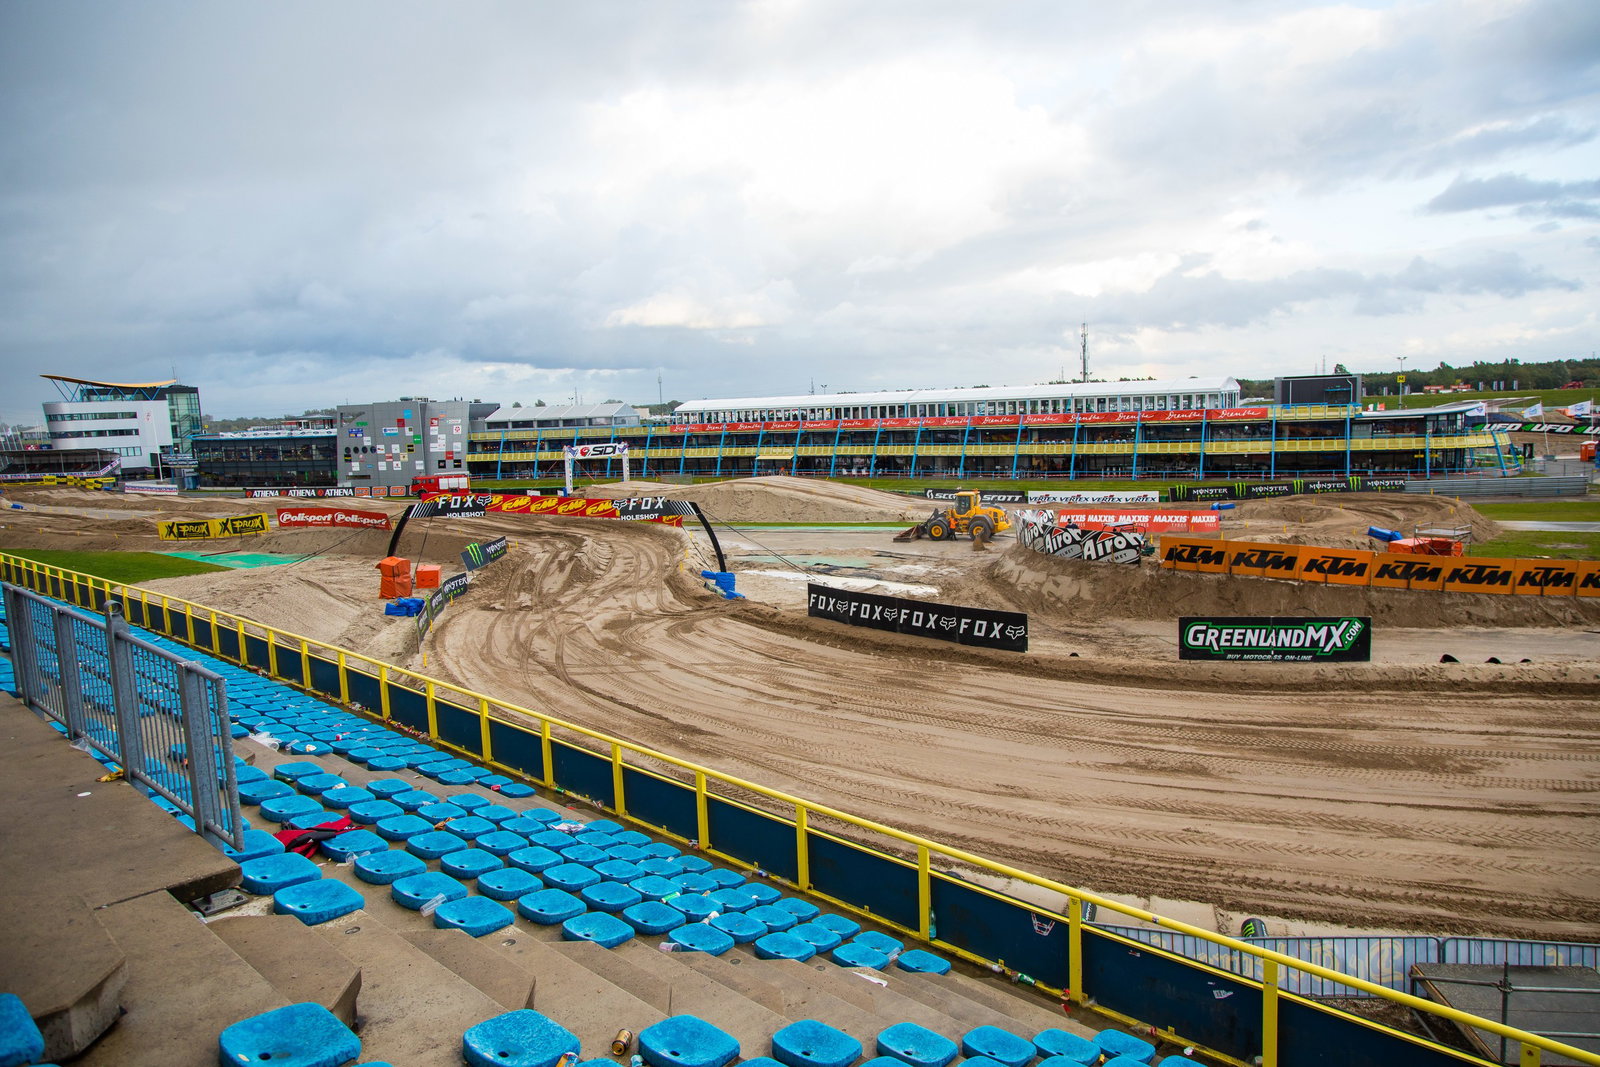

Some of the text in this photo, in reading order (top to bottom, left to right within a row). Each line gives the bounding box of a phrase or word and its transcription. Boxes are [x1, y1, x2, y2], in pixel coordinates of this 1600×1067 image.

[1531, 425, 1574, 433] UFO
[253, 490, 279, 498] ATHENA
[288, 489, 315, 497] ATHENA
[324, 488, 353, 497] ATHENA
[982, 494, 1022, 502] SCOTT
[438, 496, 475, 509] FOX
[629, 497, 665, 510] FOX
[282, 512, 387, 525] Polisport Polisport
[1060, 515, 1086, 523] MAXXIS
[1118, 515, 1149, 523] MAXXIS
[1153, 515, 1187, 523] MAXXIS
[1191, 515, 1216, 523] MAXXIS
[1165, 544, 1226, 565] KTM
[1231, 549, 1298, 571] KTM
[1303, 556, 1369, 577] KTM
[1375, 560, 1443, 582] KTM
[1447, 564, 1512, 586] KTM
[1517, 567, 1576, 588] KTM
[809, 593, 1004, 639] FOX FOX FOX FOX
